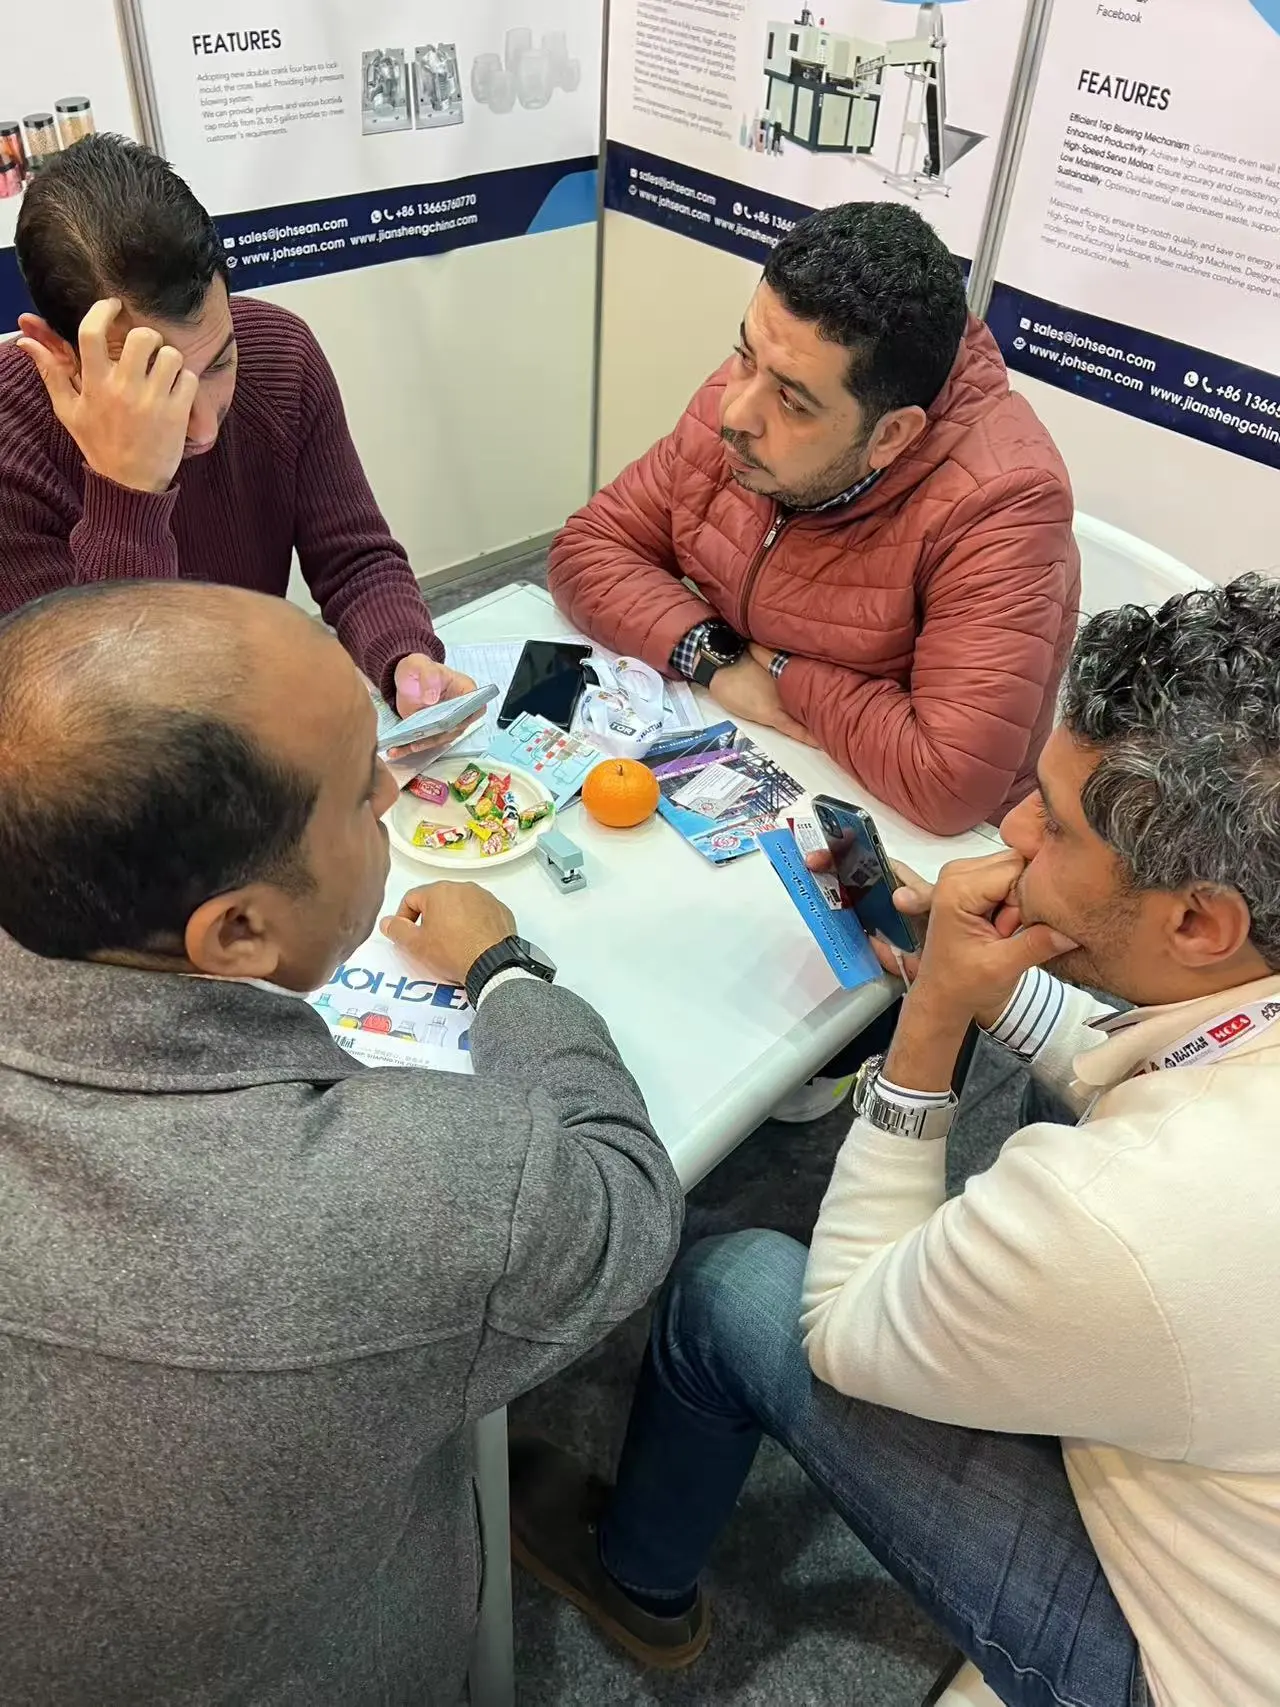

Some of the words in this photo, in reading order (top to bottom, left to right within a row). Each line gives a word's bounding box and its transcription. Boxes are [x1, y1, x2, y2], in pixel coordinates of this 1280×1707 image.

[1096, 4, 1142, 23] Facebook
[192, 29, 281, 55] FEATURES
[274, 77, 304, 87] Providing
[305, 75, 318, 84] high
[1078, 69, 1171, 110] FEATURES
[274, 115, 279, 123] 5
[286, 101, 297, 109] and
[1066, 126, 1103, 142] Enhanced
[1180, 156, 1197, 168] high
[1198, 163, 1224, 175] output
[1246, 175, 1264, 184] with
[1069, 112, 1098, 127] Efficient
[1099, 119, 1112, 132] Top
[1113, 123, 1143, 140] Blowing
[1238, 158, 1257, 167] even
[1060, 152, 1074, 163] Low
[1154, 180, 1179, 194] design
[1181, 188, 1209, 201] ensures
[1247, 205, 1263, 215] and
[1063, 138, 1105, 158] High-Speed
[1106, 150, 1127, 163] Servo
[1156, 164, 1181, 178] Ensure
[1182, 174, 1215, 189] accuracy
[1216, 182, 1232, 192] and
[638, 188, 711, 223] www.johsean.com
[639, 170, 716, 206] sales@johsean.com
[753, 211, 770, 224] +86
[1141, 191, 1171, 204] material
[1171, 200, 1184, 209] use
[1186, 202, 1223, 219] decreases
[238, 217, 349, 246] sales@johsean.com
[396, 205, 415, 221] +86
[242, 236, 345, 266] www.johsean.com
[350, 214, 478, 246] www.jianshengchina.com
[1047, 209, 1084, 228] High-Speed
[1085, 220, 1097, 233] Top
[1098, 225, 1125, 242] Blowing
[1126, 233, 1147, 247] Linear
[1148, 240, 1167, 252] Blow
[1168, 245, 1204, 264] Moulding
[1112, 218, 1135, 229] ensure
[1136, 224, 1172, 239] top-notch
[1200, 243, 1216, 252] and
[1216, 247, 1234, 257] save
[1235, 252, 1245, 260] on
[1247, 255, 1274, 270] energy
[1071, 245, 1107, 262] production
[1154, 255, 1175, 268] these
[1175, 263, 1211, 279] machines
[1212, 273, 1245, 288] combine
[1246, 283, 1271, 296] speed
[1029, 342, 1144, 391] www.johsean.com
[1032, 320, 1157, 372] sales@johsean.com
[1216, 385, 1241, 402] +86
[1172, 1036, 1209, 1063] HAITIAN
